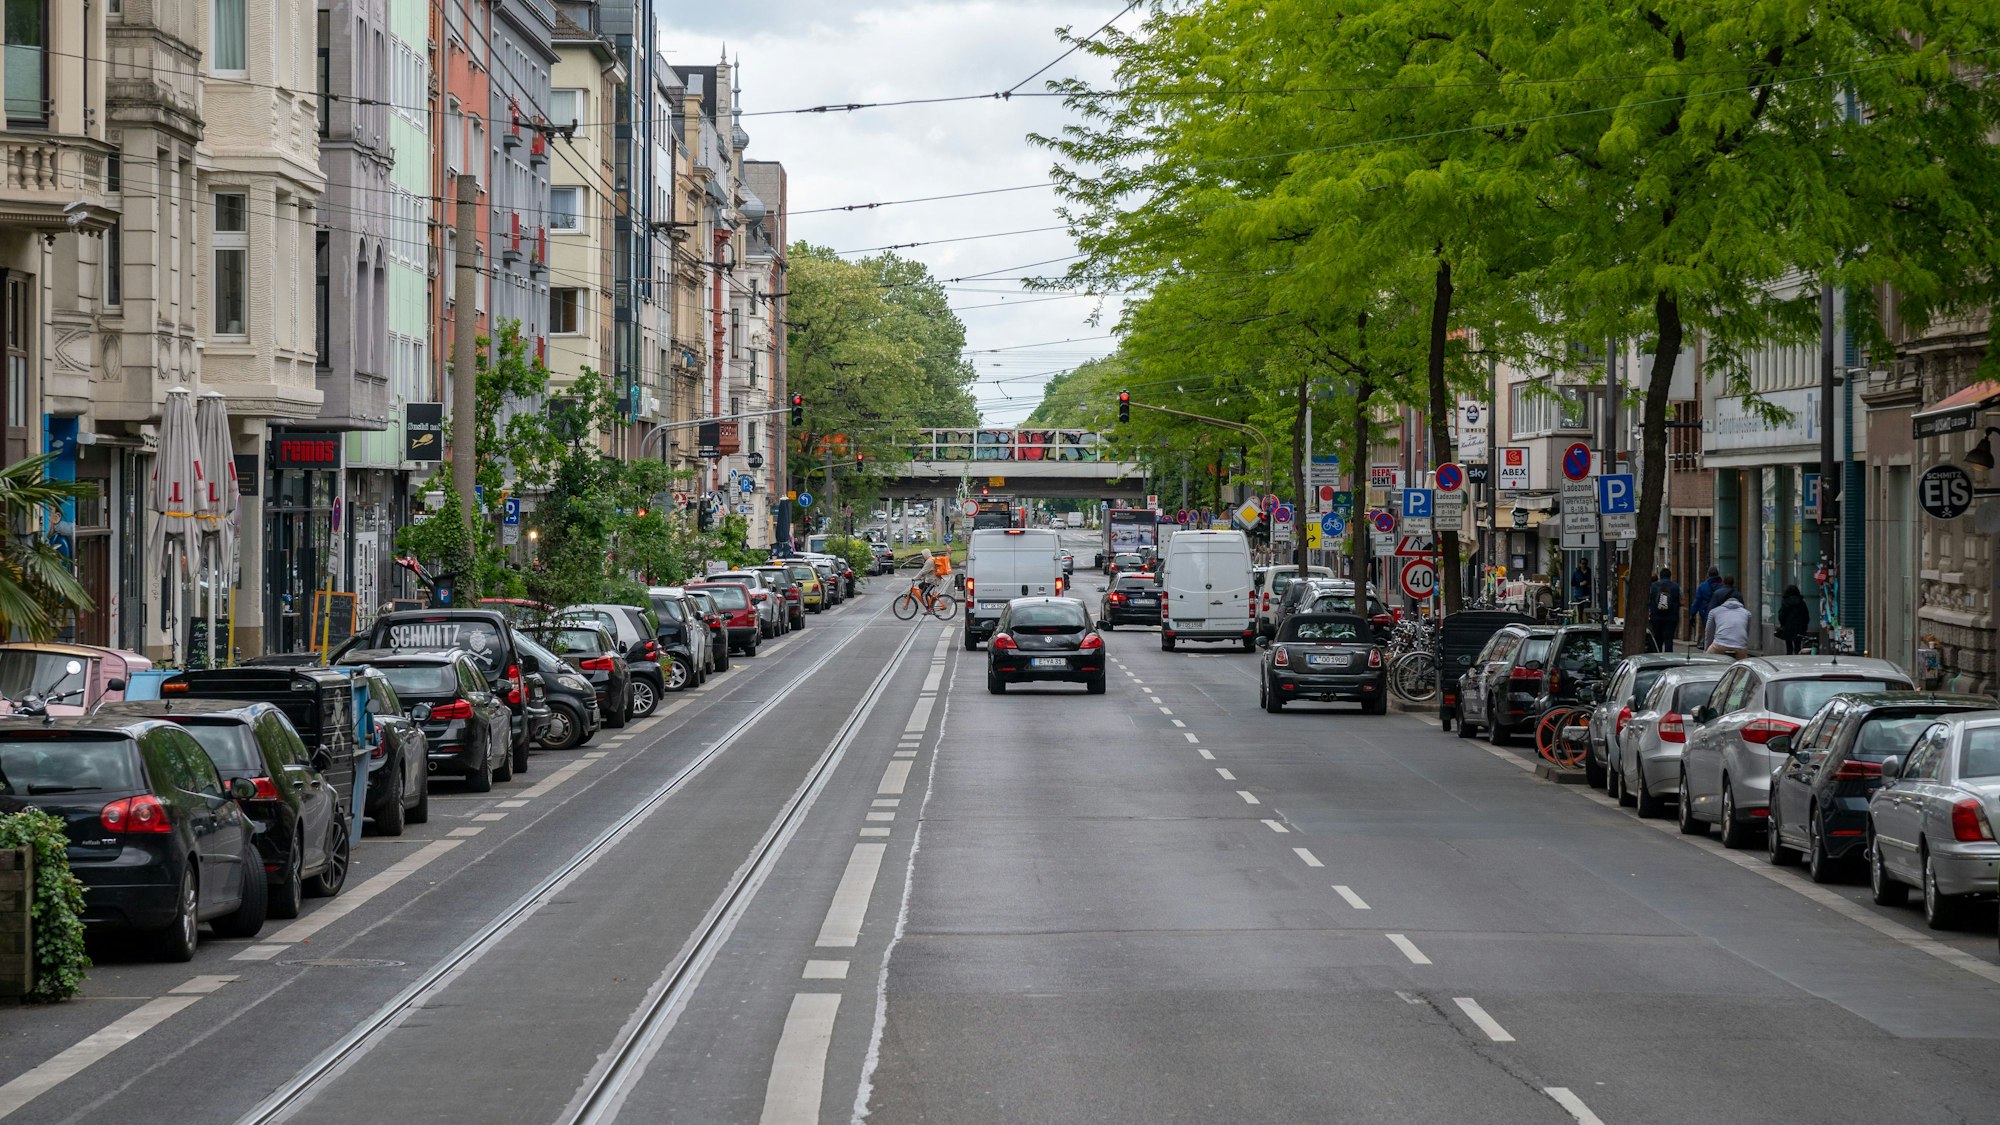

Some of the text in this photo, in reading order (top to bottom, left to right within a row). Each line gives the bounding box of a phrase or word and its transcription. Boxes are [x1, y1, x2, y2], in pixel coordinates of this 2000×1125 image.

[281, 440, 334, 462] remos
[1469, 468, 1487, 480] sky
[1502, 468, 1527, 476] ABEX
[1926, 471, 1962, 480] SCHMITZ
[1563, 483, 1592, 492] Ladezone
[1607, 480, 1626, 510] P
[1924, 478, 1969, 507] EIS
[1409, 491, 1426, 514] P
[1565, 498, 1593, 506] werktags
[1566, 523, 1595, 531] Seitenstreifen
[1409, 570, 1432, 588] 40
[389, 624, 461, 648] SCHMITZ
